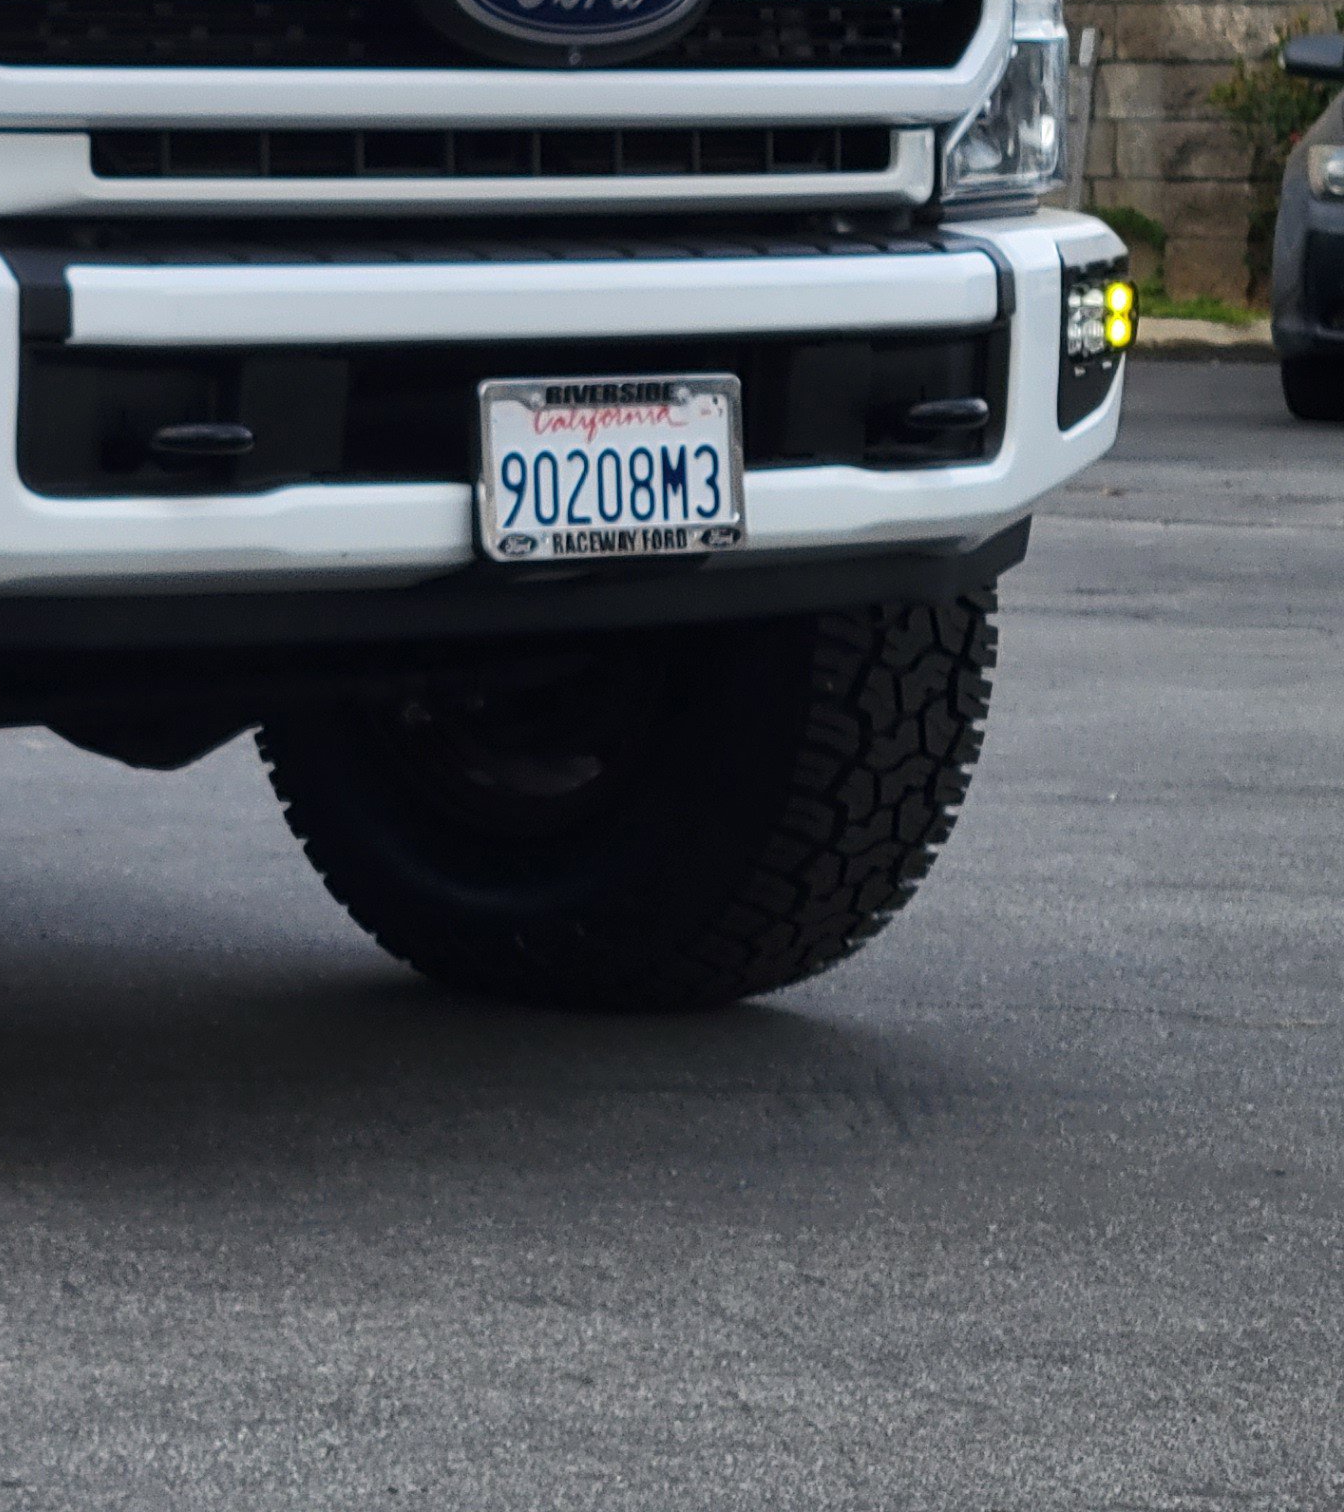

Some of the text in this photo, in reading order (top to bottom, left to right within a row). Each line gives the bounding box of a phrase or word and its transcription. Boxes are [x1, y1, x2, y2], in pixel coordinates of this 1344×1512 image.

[545, 382, 678, 405] RIVERSIDE
[500, 444, 721, 529] 90208M3
[552, 527, 689, 555] RACEWAY FORD
